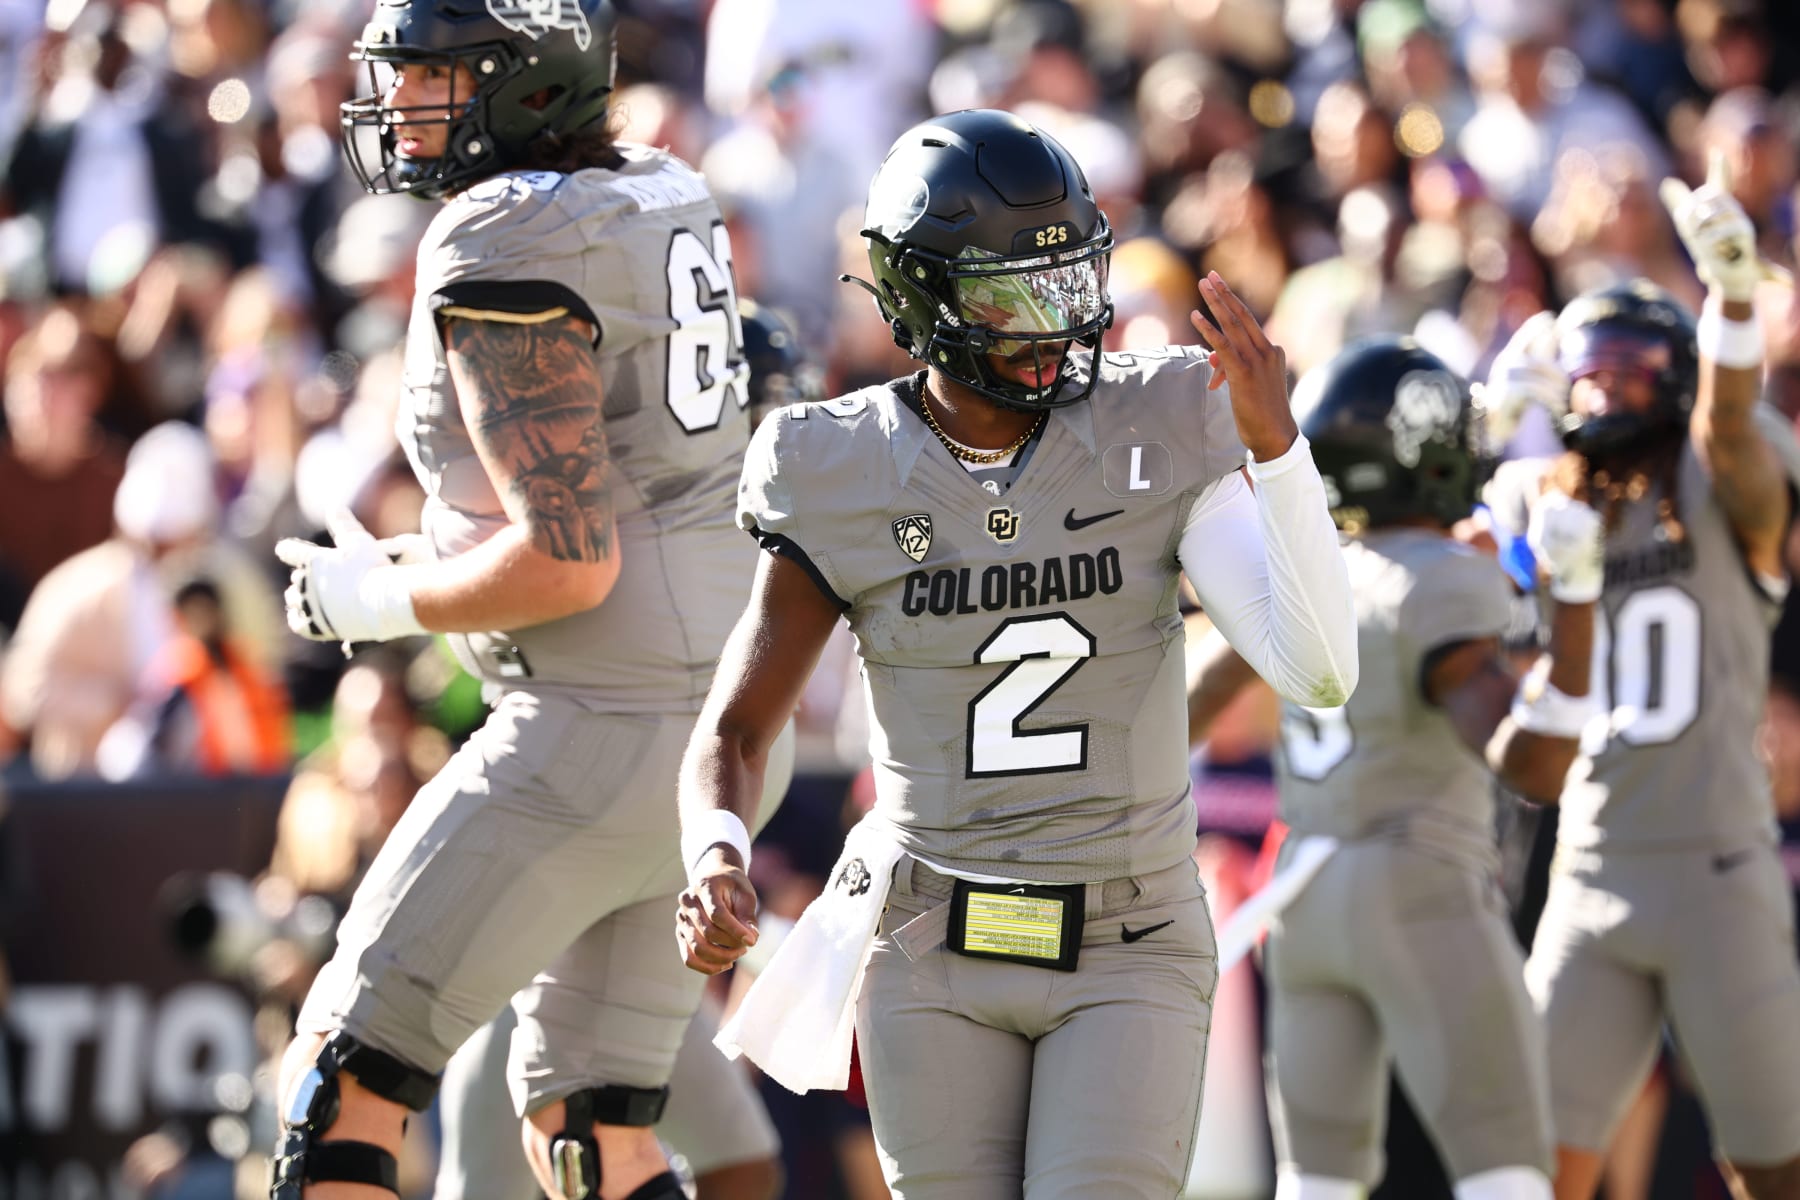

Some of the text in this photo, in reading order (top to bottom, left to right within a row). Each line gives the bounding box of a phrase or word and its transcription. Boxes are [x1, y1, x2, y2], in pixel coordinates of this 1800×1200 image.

[1129, 446, 1151, 490] L
[894, 517, 930, 547] PAC
[905, 535, 926, 554] 12
[986, 507, 1020, 542] CU
[901, 546, 1124, 617] COLORADO
[965, 610, 1097, 780] 2
[0, 982, 252, 1132] TIO
